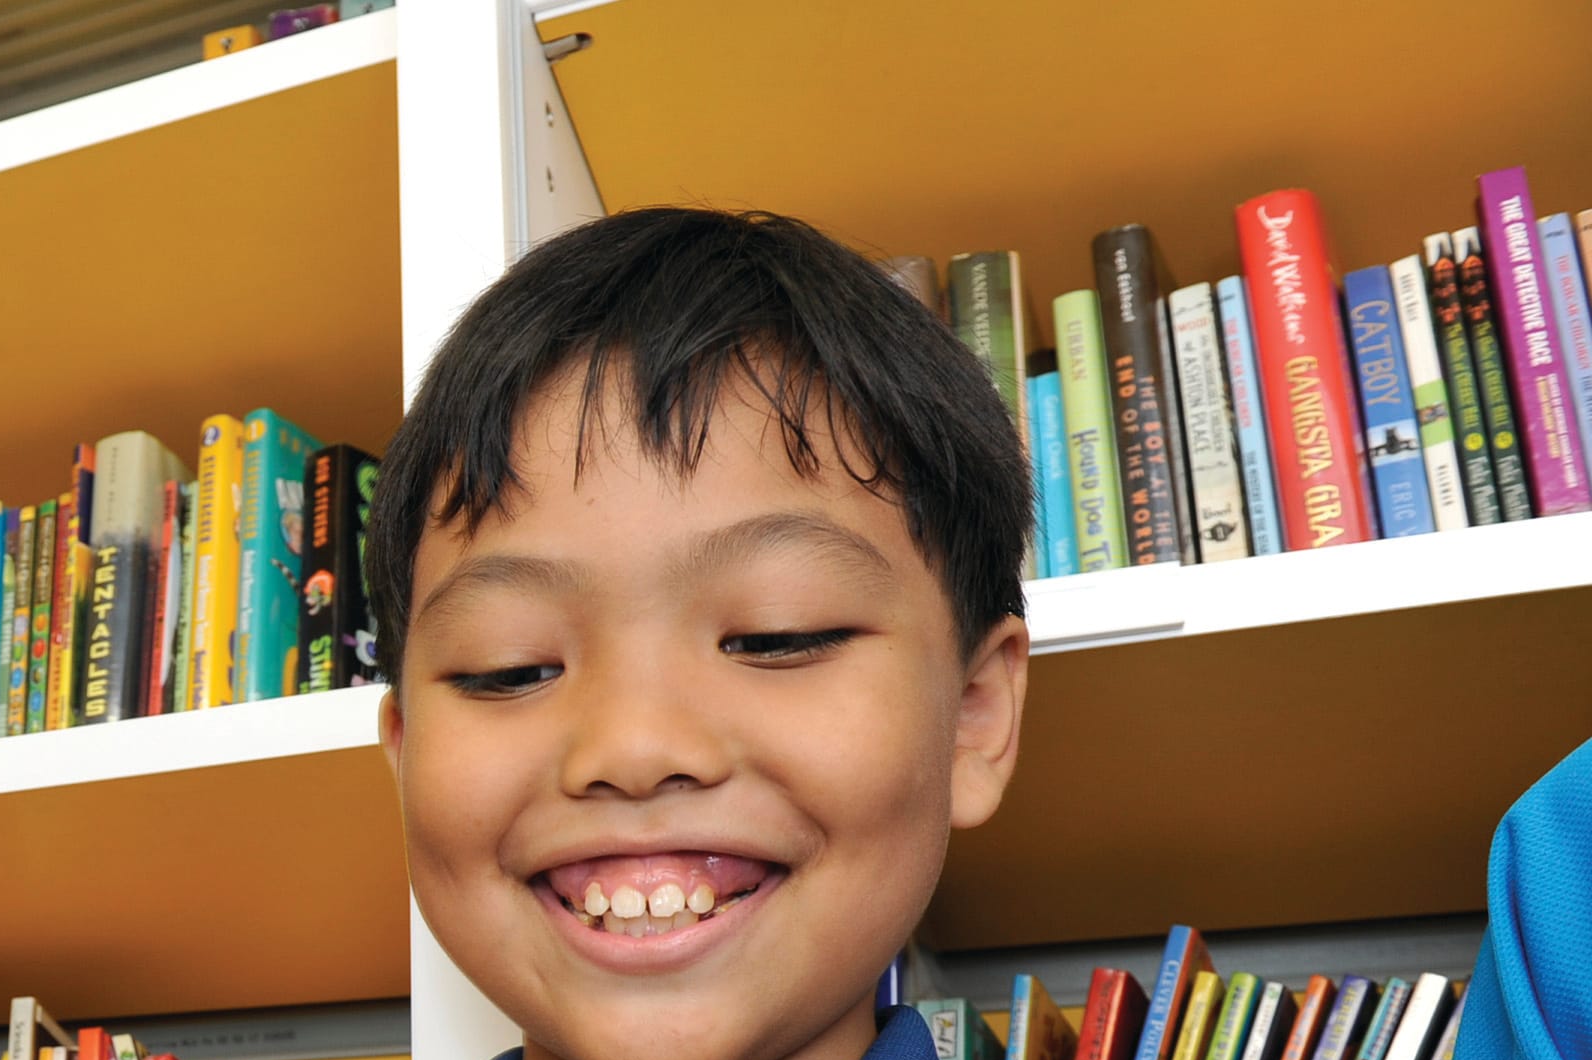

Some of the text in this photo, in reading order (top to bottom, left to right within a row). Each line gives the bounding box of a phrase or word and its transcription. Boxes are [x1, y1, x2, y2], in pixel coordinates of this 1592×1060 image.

[1115, 248, 1130, 273] van
[1257, 206, 1301, 267] David
[971, 262, 989, 312] VANDE
[1499, 195, 1553, 367] THE GREAT DETECTIVE RACE
[1067, 320, 1088, 382] URBAN
[1350, 300, 1401, 409] CATBOY
[1182, 356, 1205, 409] ASHTON
[1191, 412, 1211, 454] PLACE
[1208, 409, 1224, 453] CHILDREN
[1284, 355, 1334, 479] GANGSTA
[1115, 355, 1156, 565] END OF THE WORLD
[1140, 375, 1174, 547] THE BOY AT THE
[312, 486, 329, 548] STEVENS
[1246, 451, 1257, 466] THE
[1254, 518, 1266, 532] THE
[1389, 481, 1417, 521] ERIC
[84, 545, 118, 718] TENTACLES
[1151, 960, 1181, 1014] CLEVER
